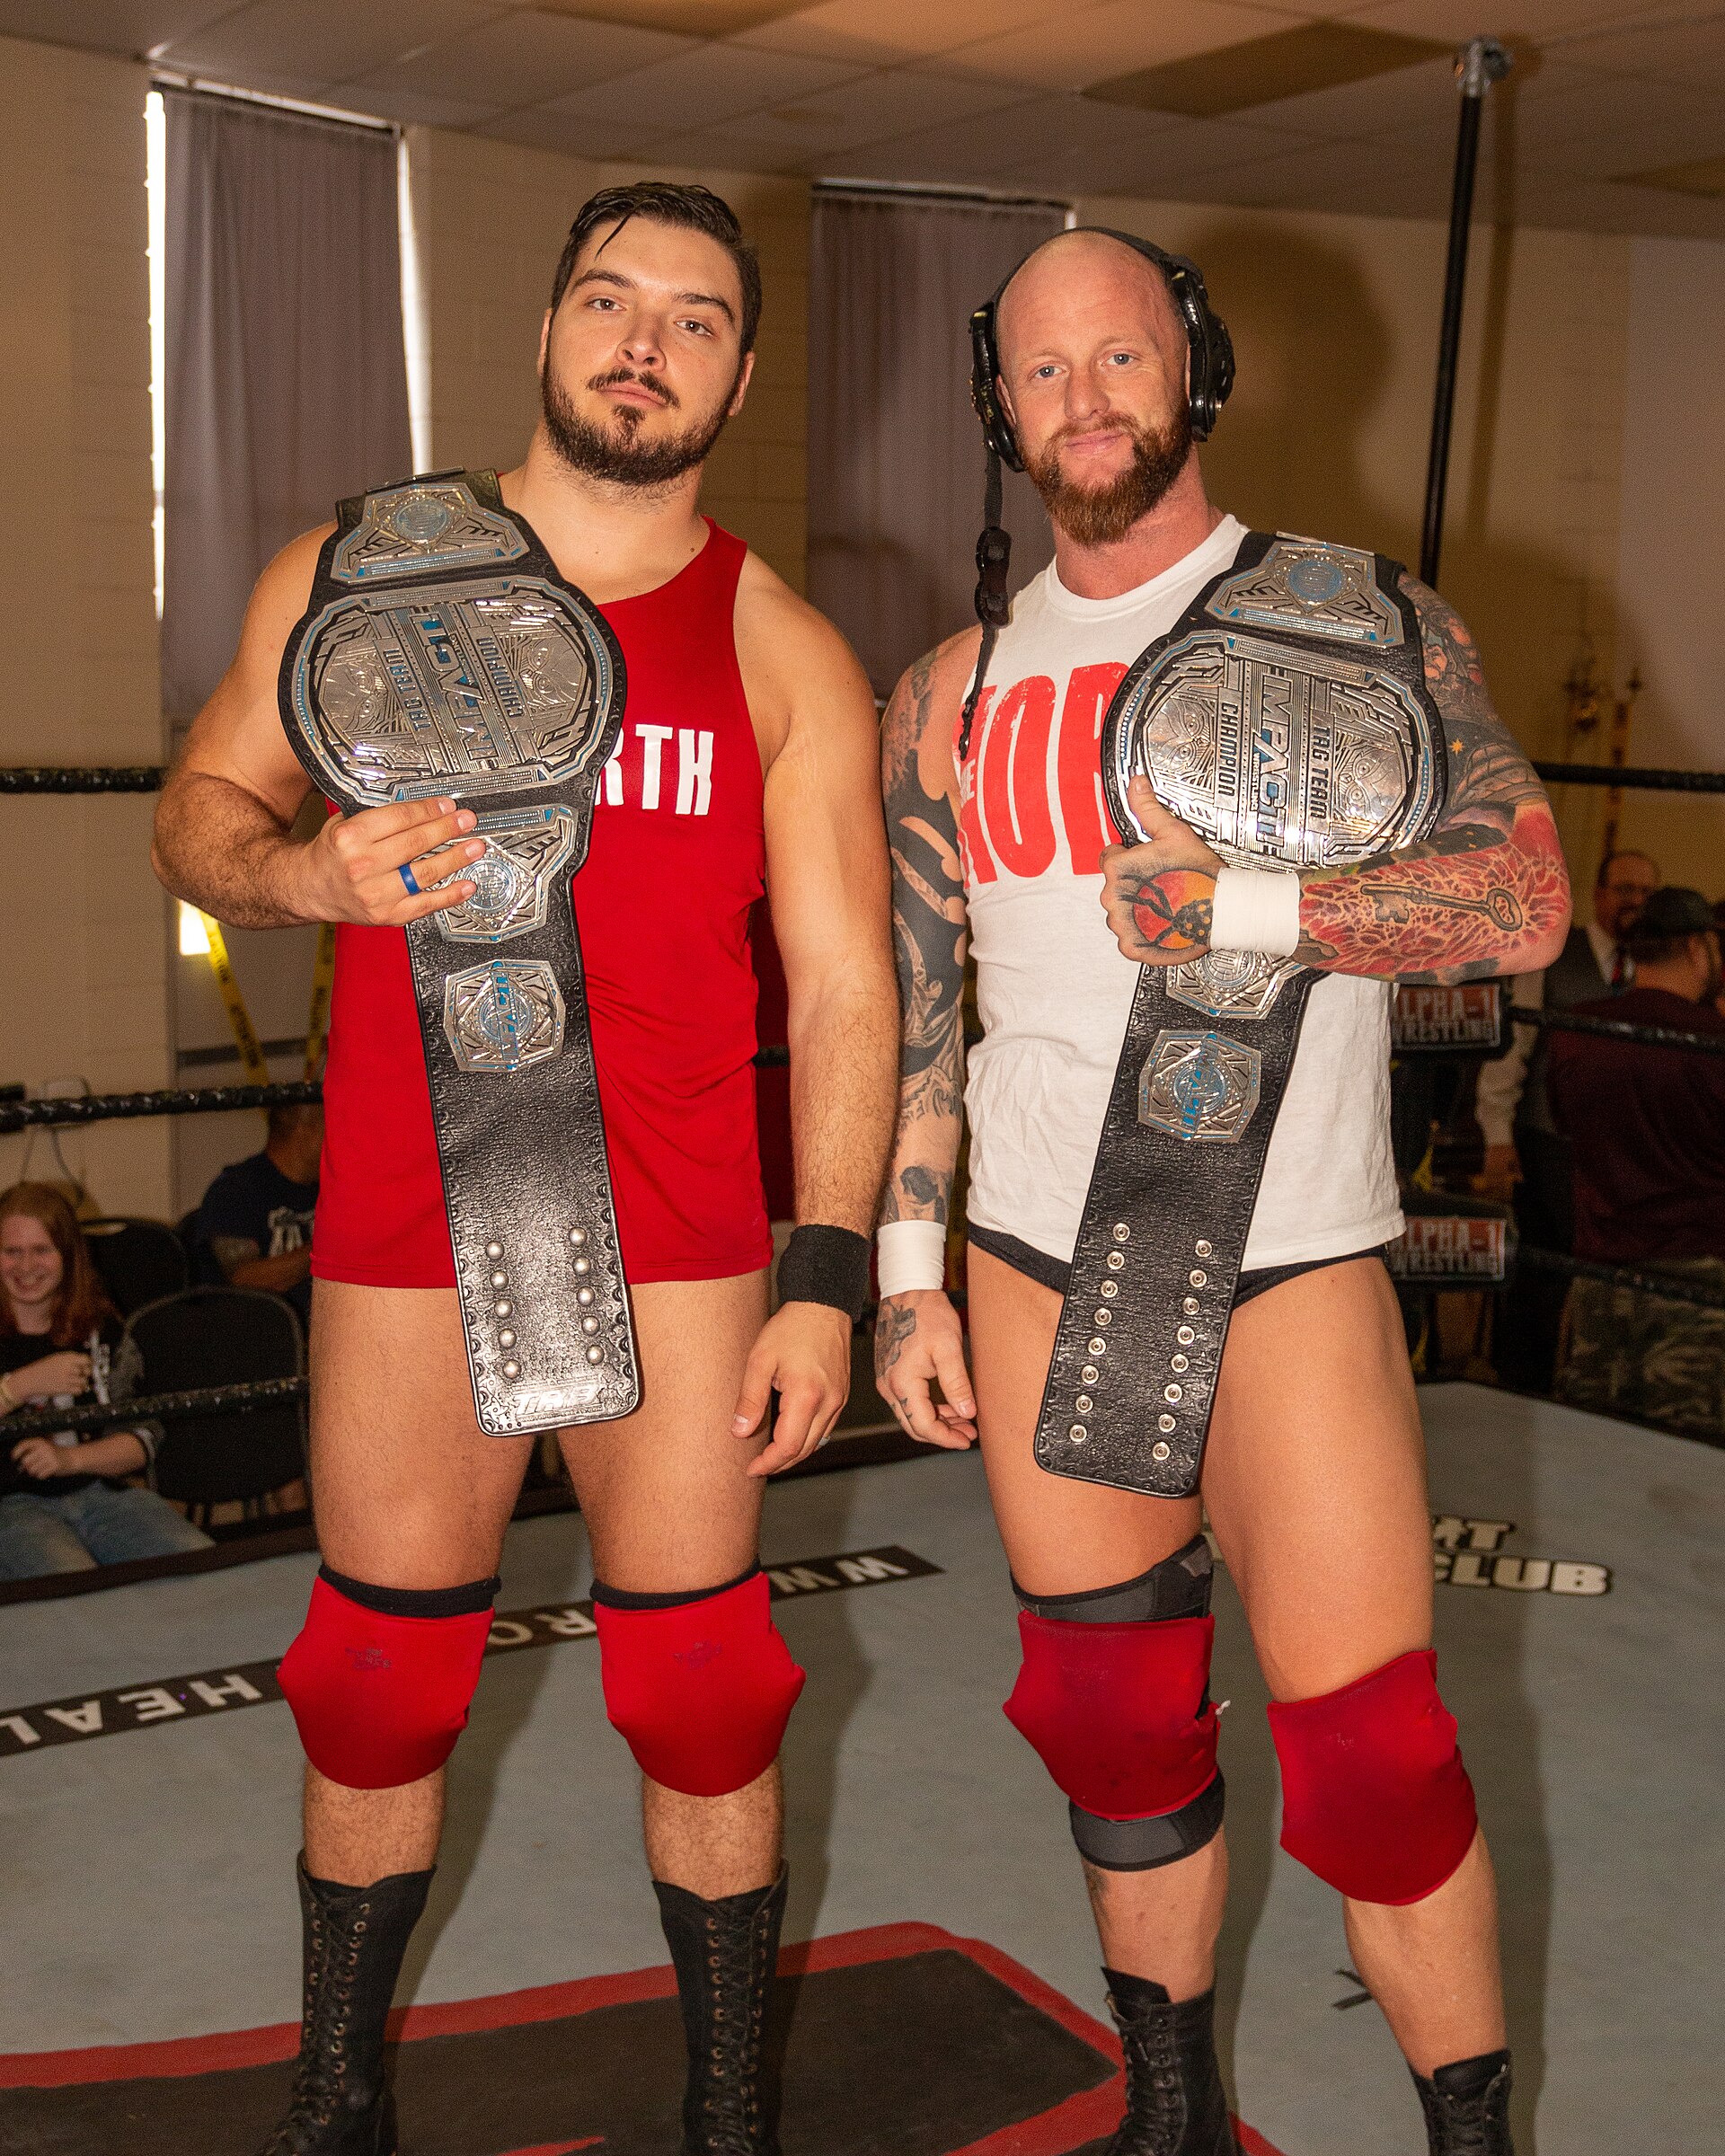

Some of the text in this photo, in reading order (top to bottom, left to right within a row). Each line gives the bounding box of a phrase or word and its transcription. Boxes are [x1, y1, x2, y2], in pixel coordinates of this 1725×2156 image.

[383, 649, 431, 731] TAG TEAM
[476, 637, 526, 718] CHAMPION
[1218, 702, 1239, 797] CHAMPION
[1251, 753, 1261, 812] WRESTLING
[1311, 725, 1331, 819] TAG TEAM
